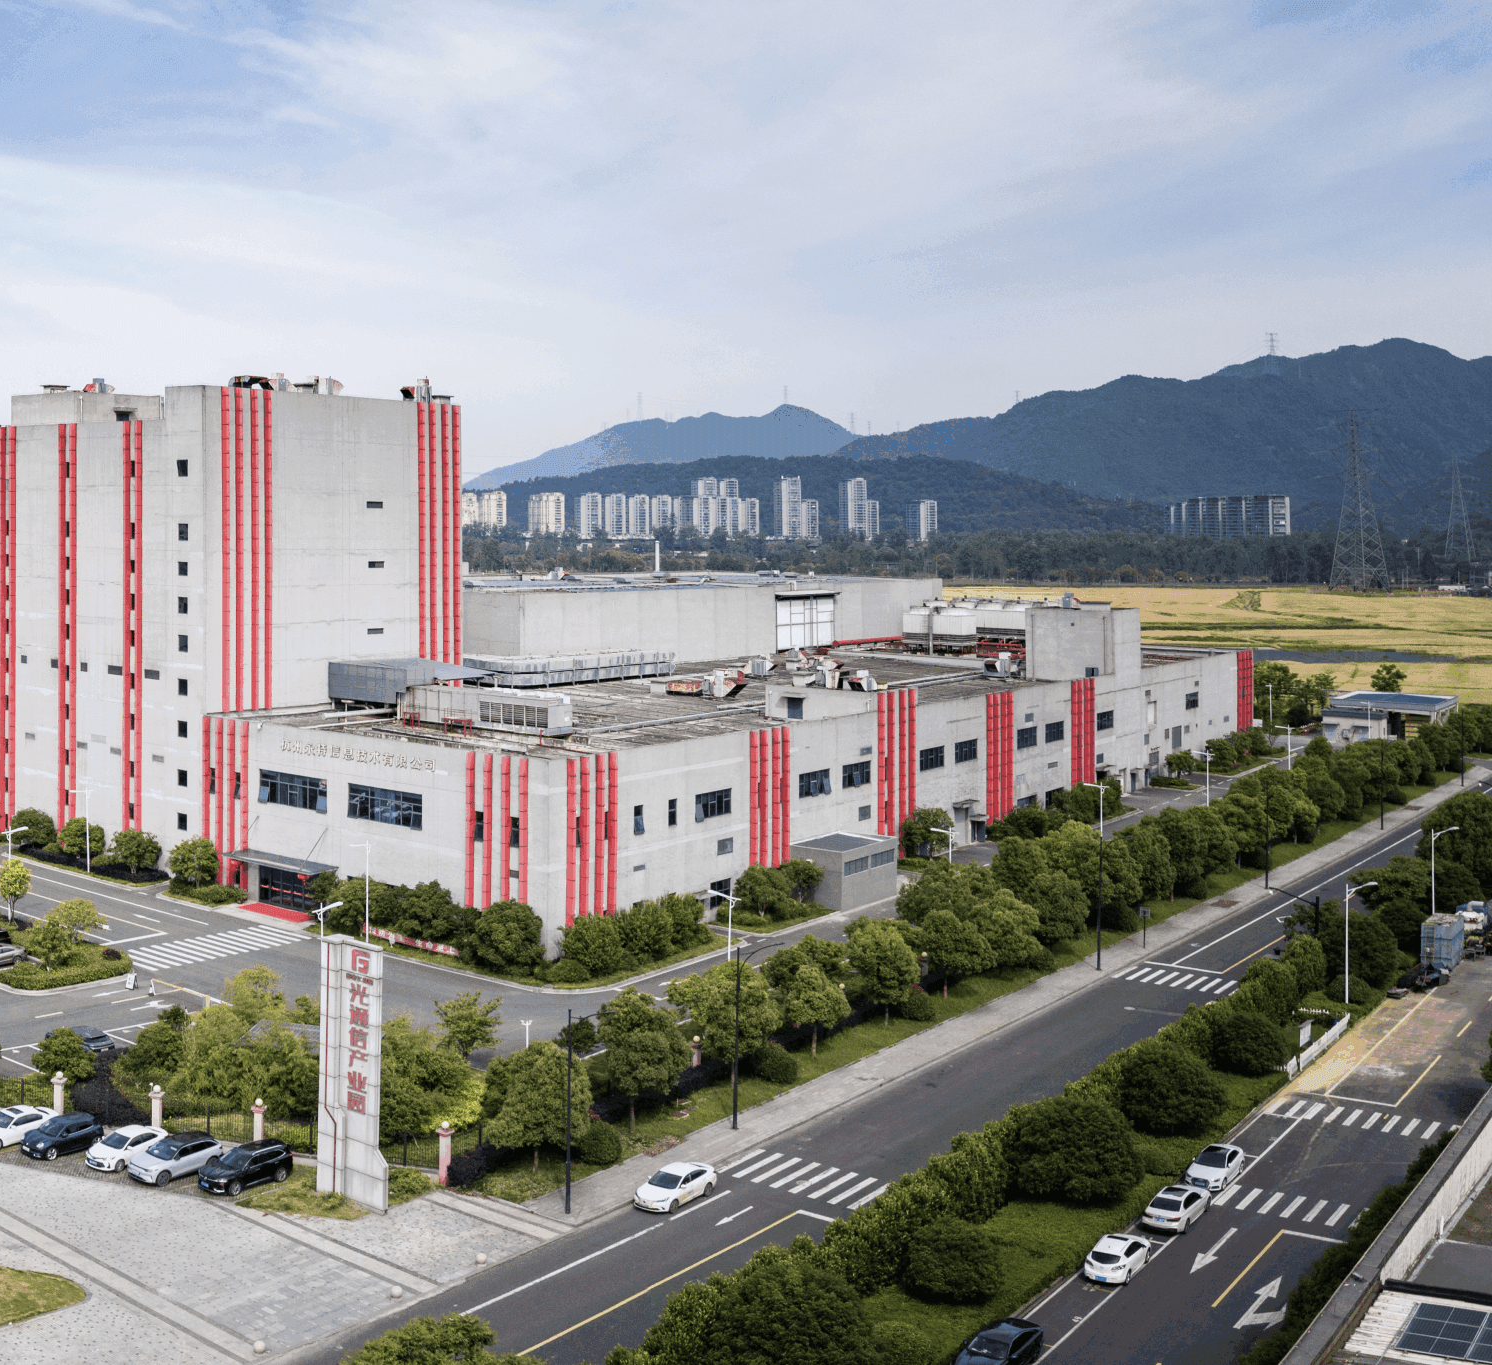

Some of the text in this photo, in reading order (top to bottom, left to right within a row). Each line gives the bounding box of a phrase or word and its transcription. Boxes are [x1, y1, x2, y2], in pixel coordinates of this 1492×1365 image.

[280, 738, 436, 772] 杭州永特信息技术有限公司
[347, 982, 369, 1115] 光通信产业园
